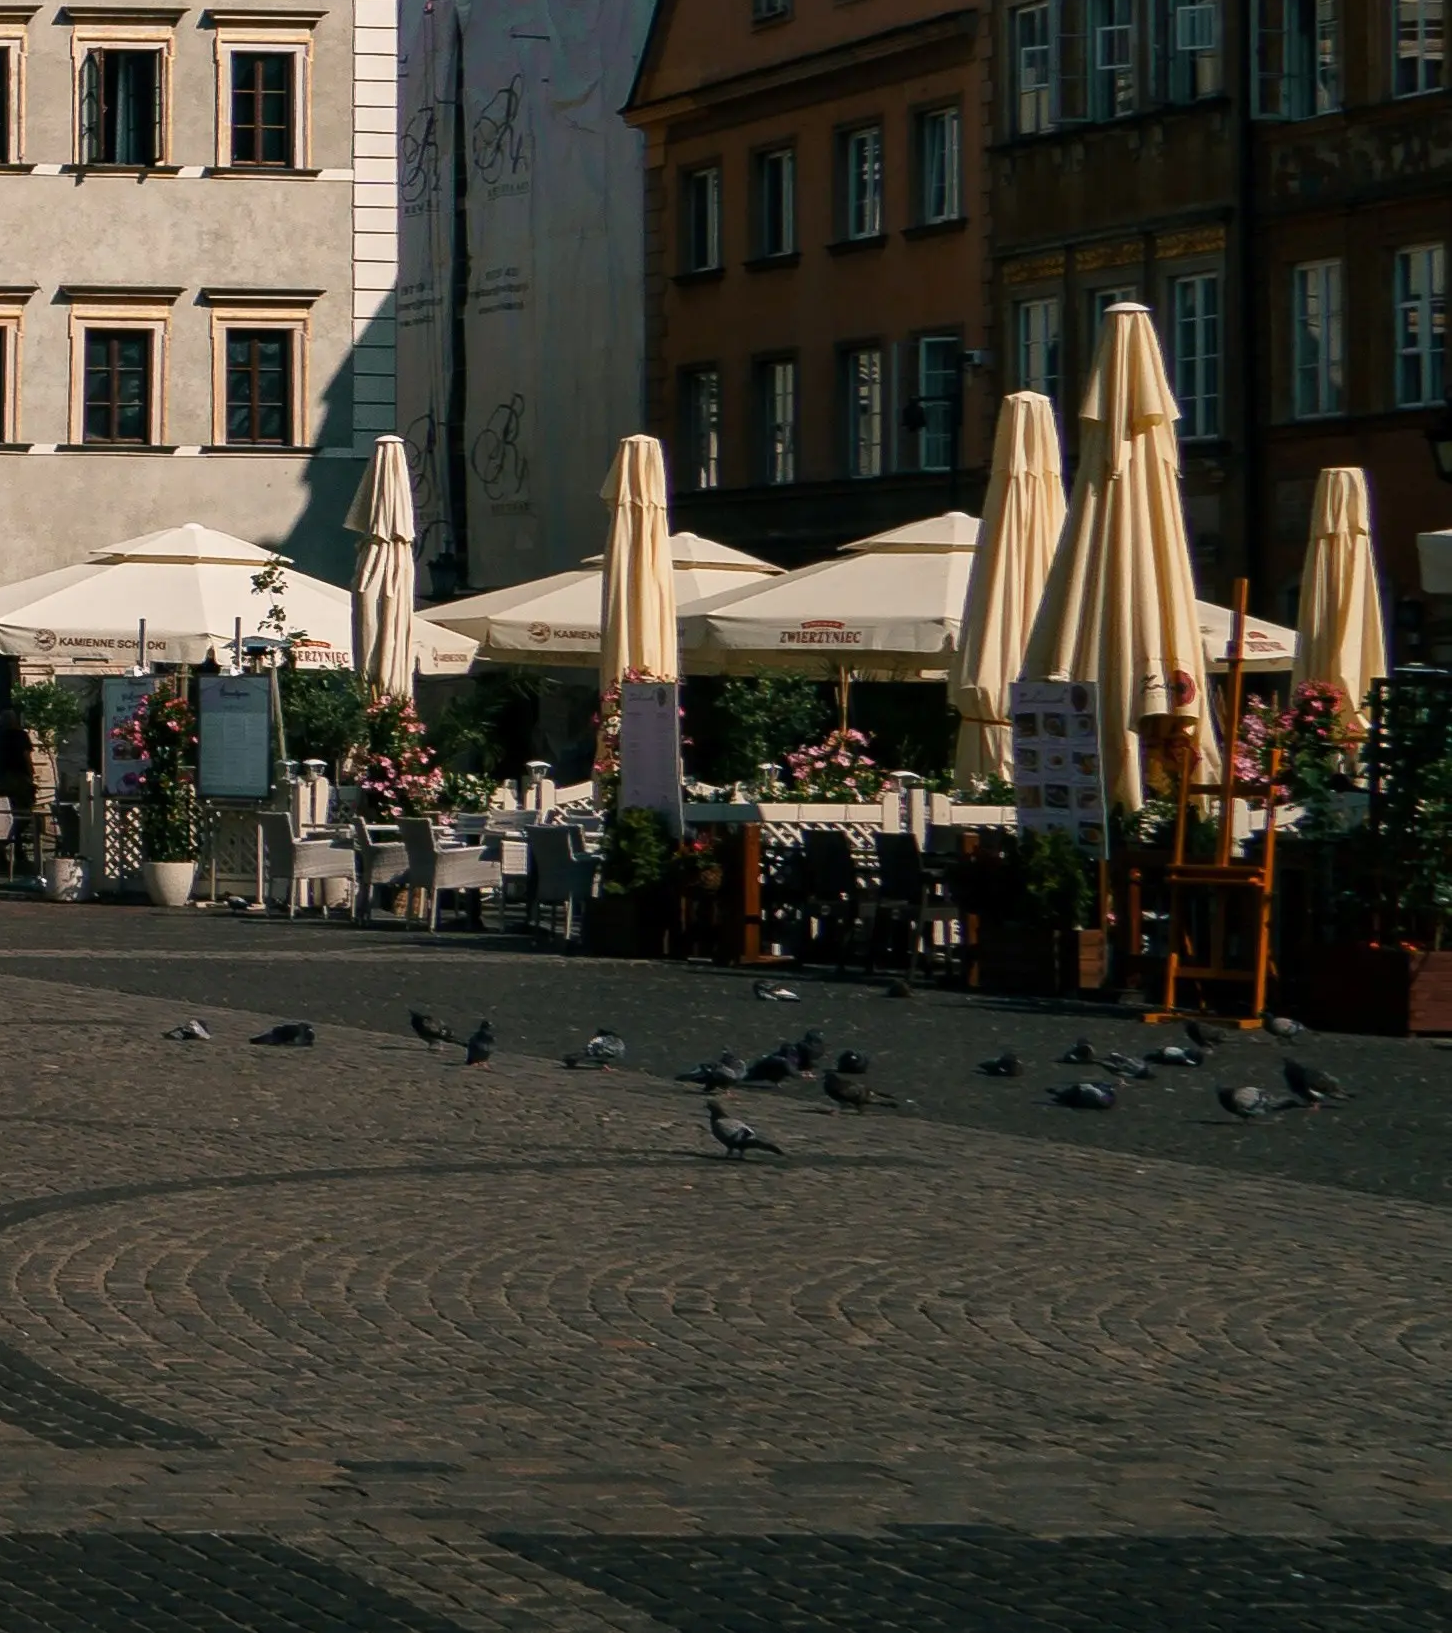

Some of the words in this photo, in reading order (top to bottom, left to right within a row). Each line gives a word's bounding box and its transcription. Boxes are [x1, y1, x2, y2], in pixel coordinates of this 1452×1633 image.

[553, 629, 602, 640] KAMIENN
[779, 631, 862, 644] ZWIERZYNIEC
[58, 637, 115, 649] KAMIENNE
[116, 639, 166, 651] SCHDKI
